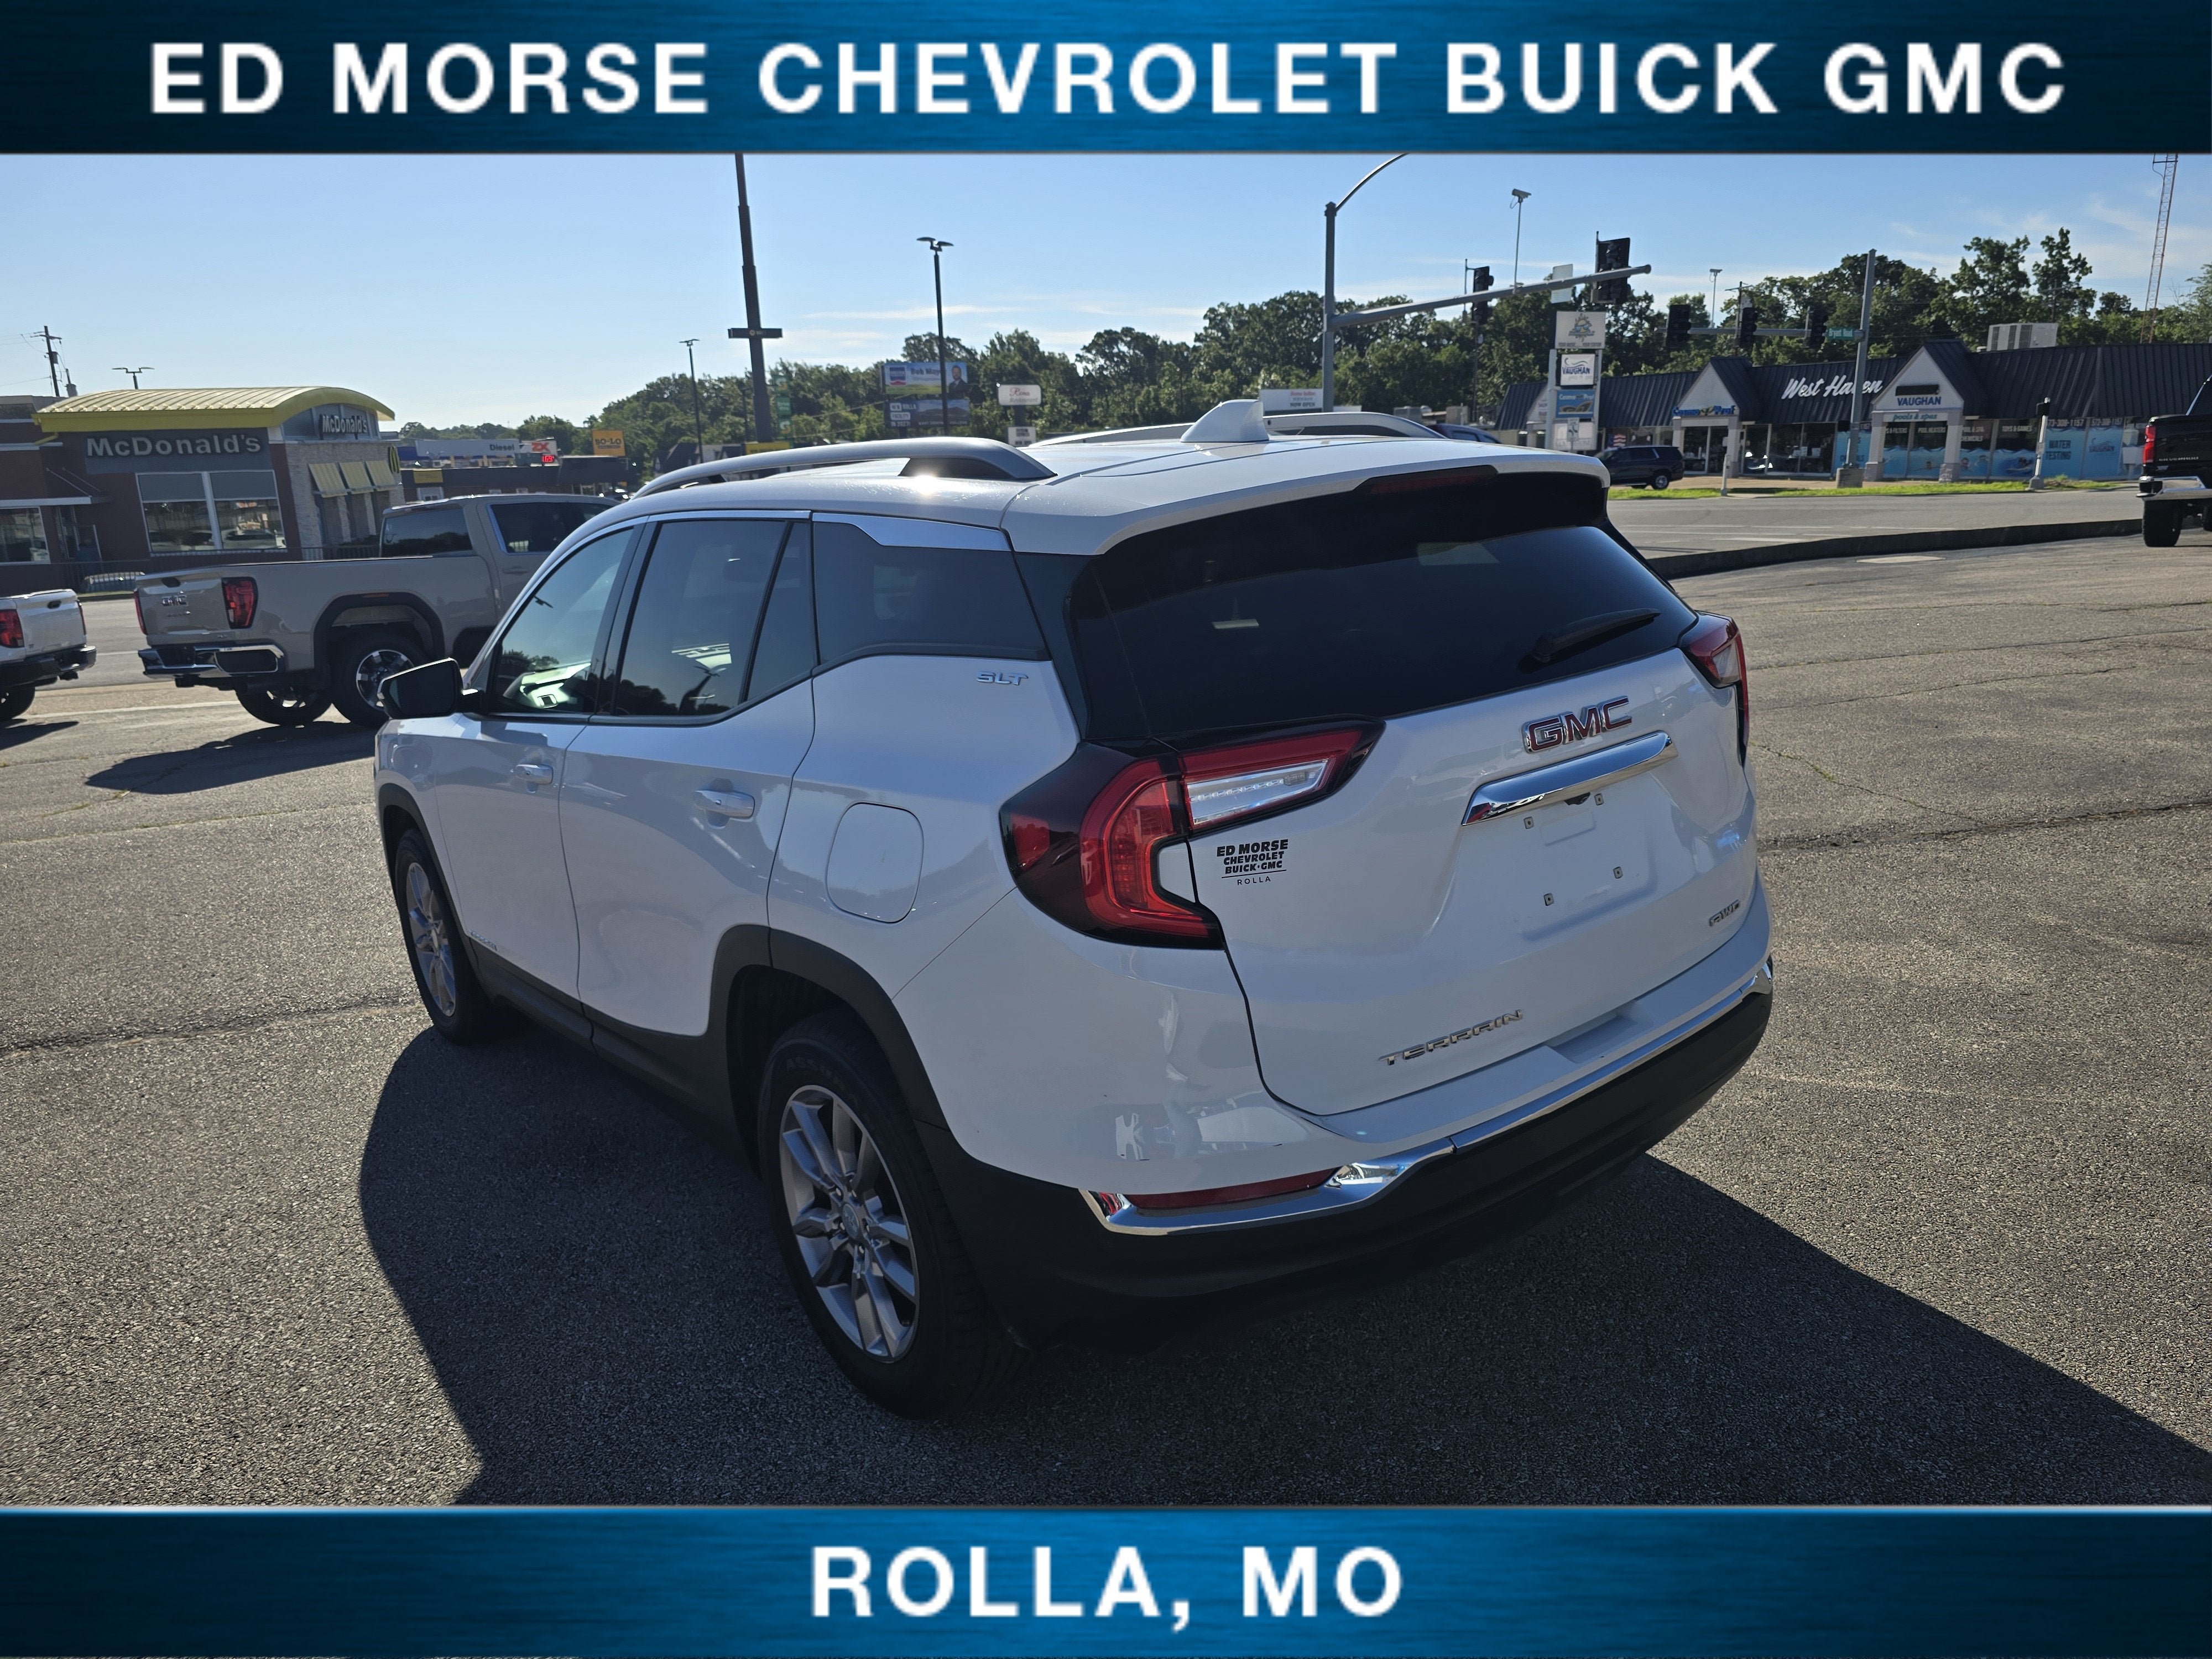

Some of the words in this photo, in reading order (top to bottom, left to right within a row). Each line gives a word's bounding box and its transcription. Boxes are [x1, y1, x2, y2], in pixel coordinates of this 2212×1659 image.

[1562, 367, 1590, 375] VAUGHAN
[1781, 377, 1824, 399] West
[1823, 374, 1883, 397] Haen
[1897, 397, 1942, 406] VAUGHAN
[1893, 413, 1913, 421] pools
[1921, 413, 1938, 421] spas
[2047, 419, 2084, 427] 73-308-1157
[322, 414, 368, 435] McDonald's
[87, 434, 261, 456] McDonald's
[2049, 440, 2072, 448] WATER
[2046, 451, 2072, 460] TESTING
[975, 671, 1029, 686] SLT
[1522, 695, 1632, 753] GMC
[1217, 845, 1236, 857] ED
[1238, 839, 1288, 854] MORSE
[1223, 851, 1285, 865] CHEVROLET
[1237, 876, 1271, 886] ROLLA
[1379, 1009, 1524, 1066] TERRAIN
